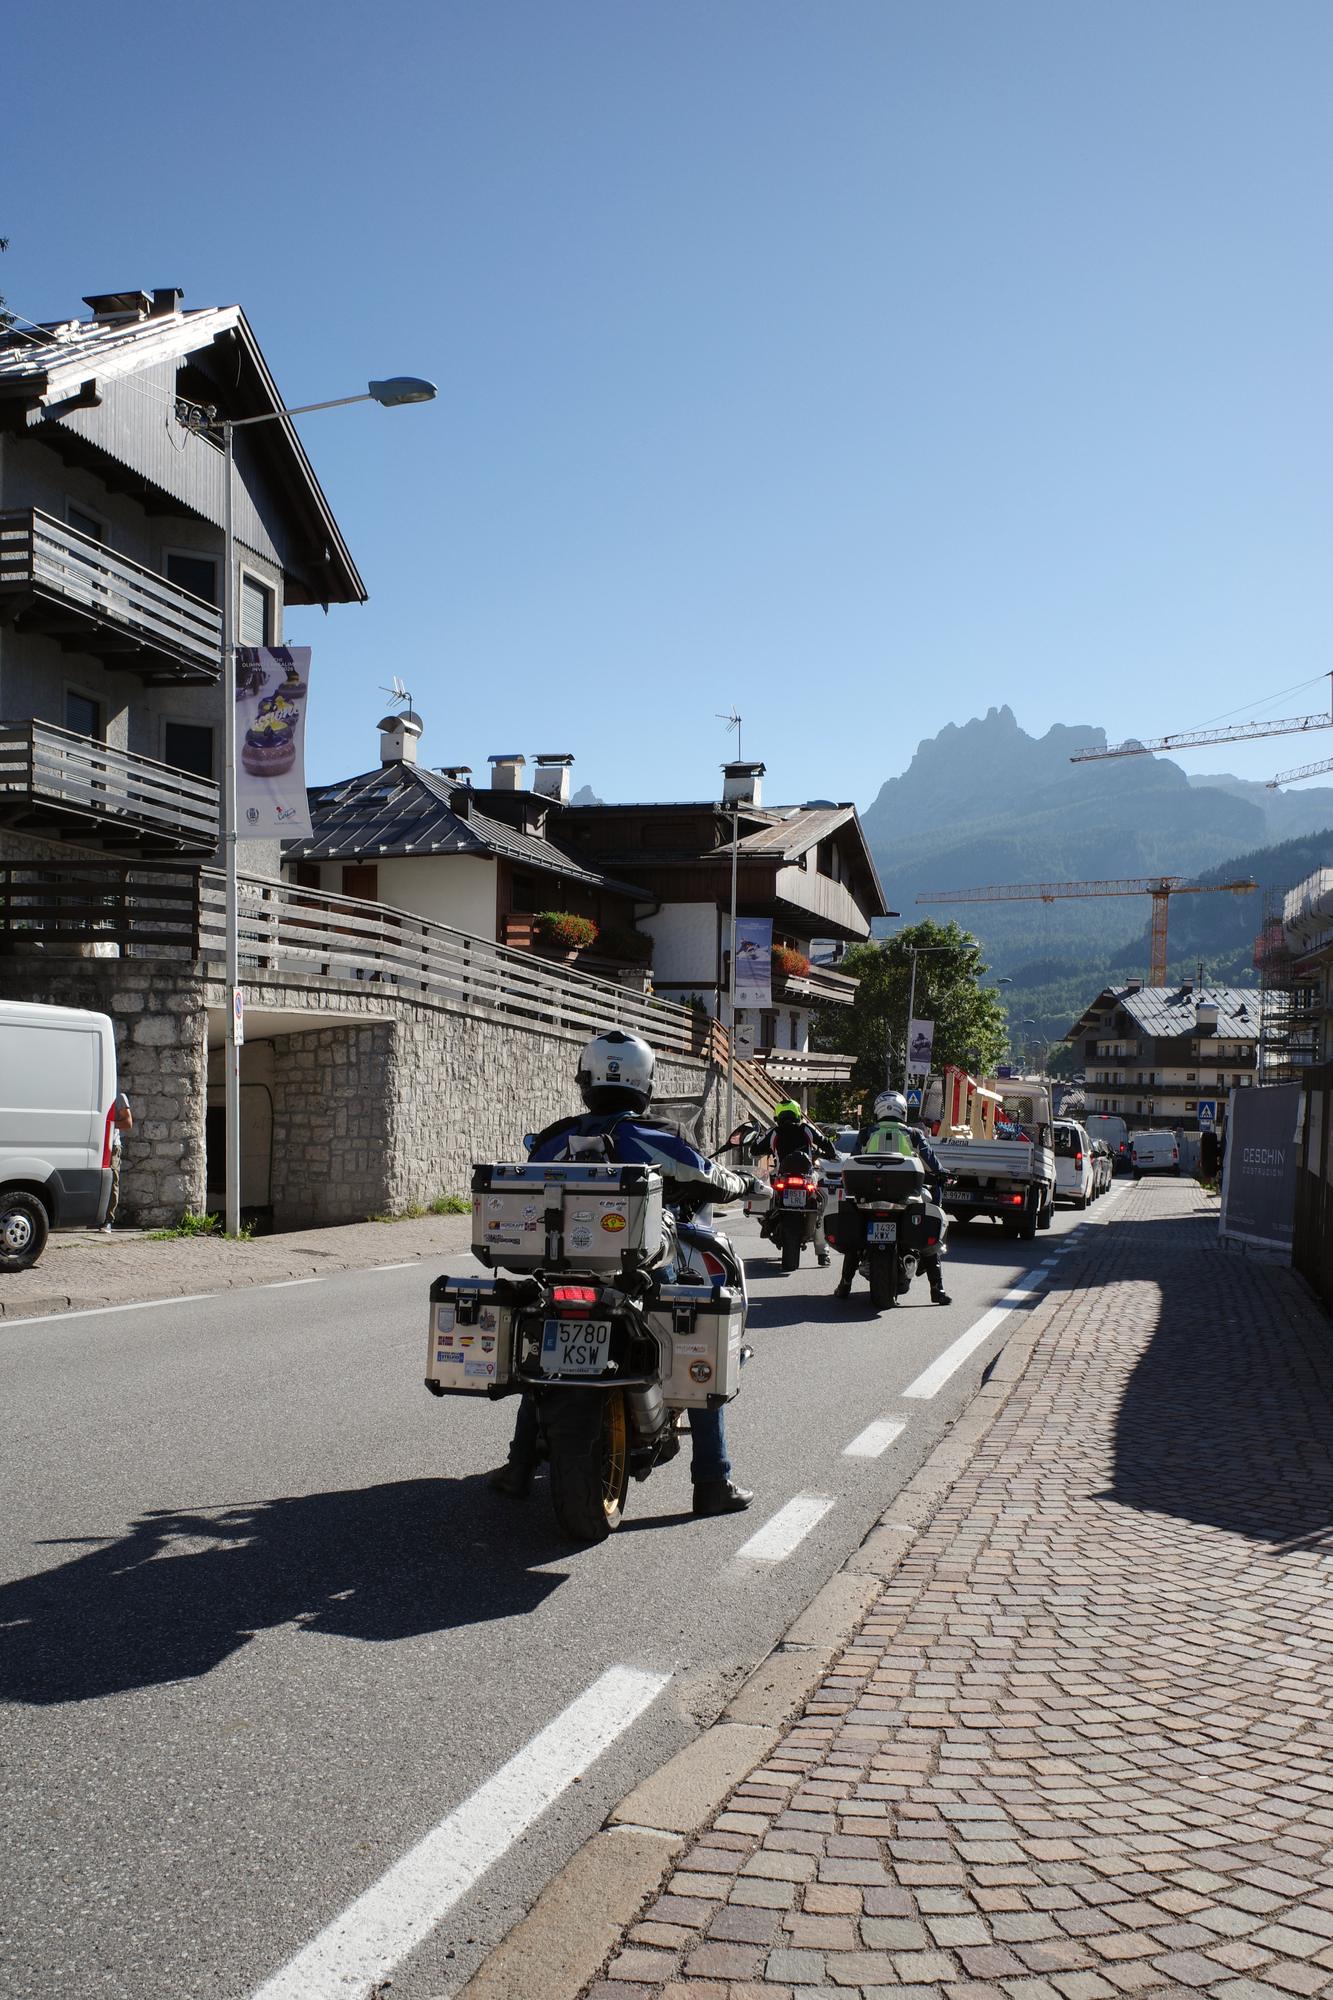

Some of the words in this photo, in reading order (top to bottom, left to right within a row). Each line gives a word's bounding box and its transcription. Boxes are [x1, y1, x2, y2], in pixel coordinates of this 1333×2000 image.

[875, 1223, 896, 1232] 1432
[559, 1323, 607, 1344] 5780
[563, 1345, 599, 1365] KSW
